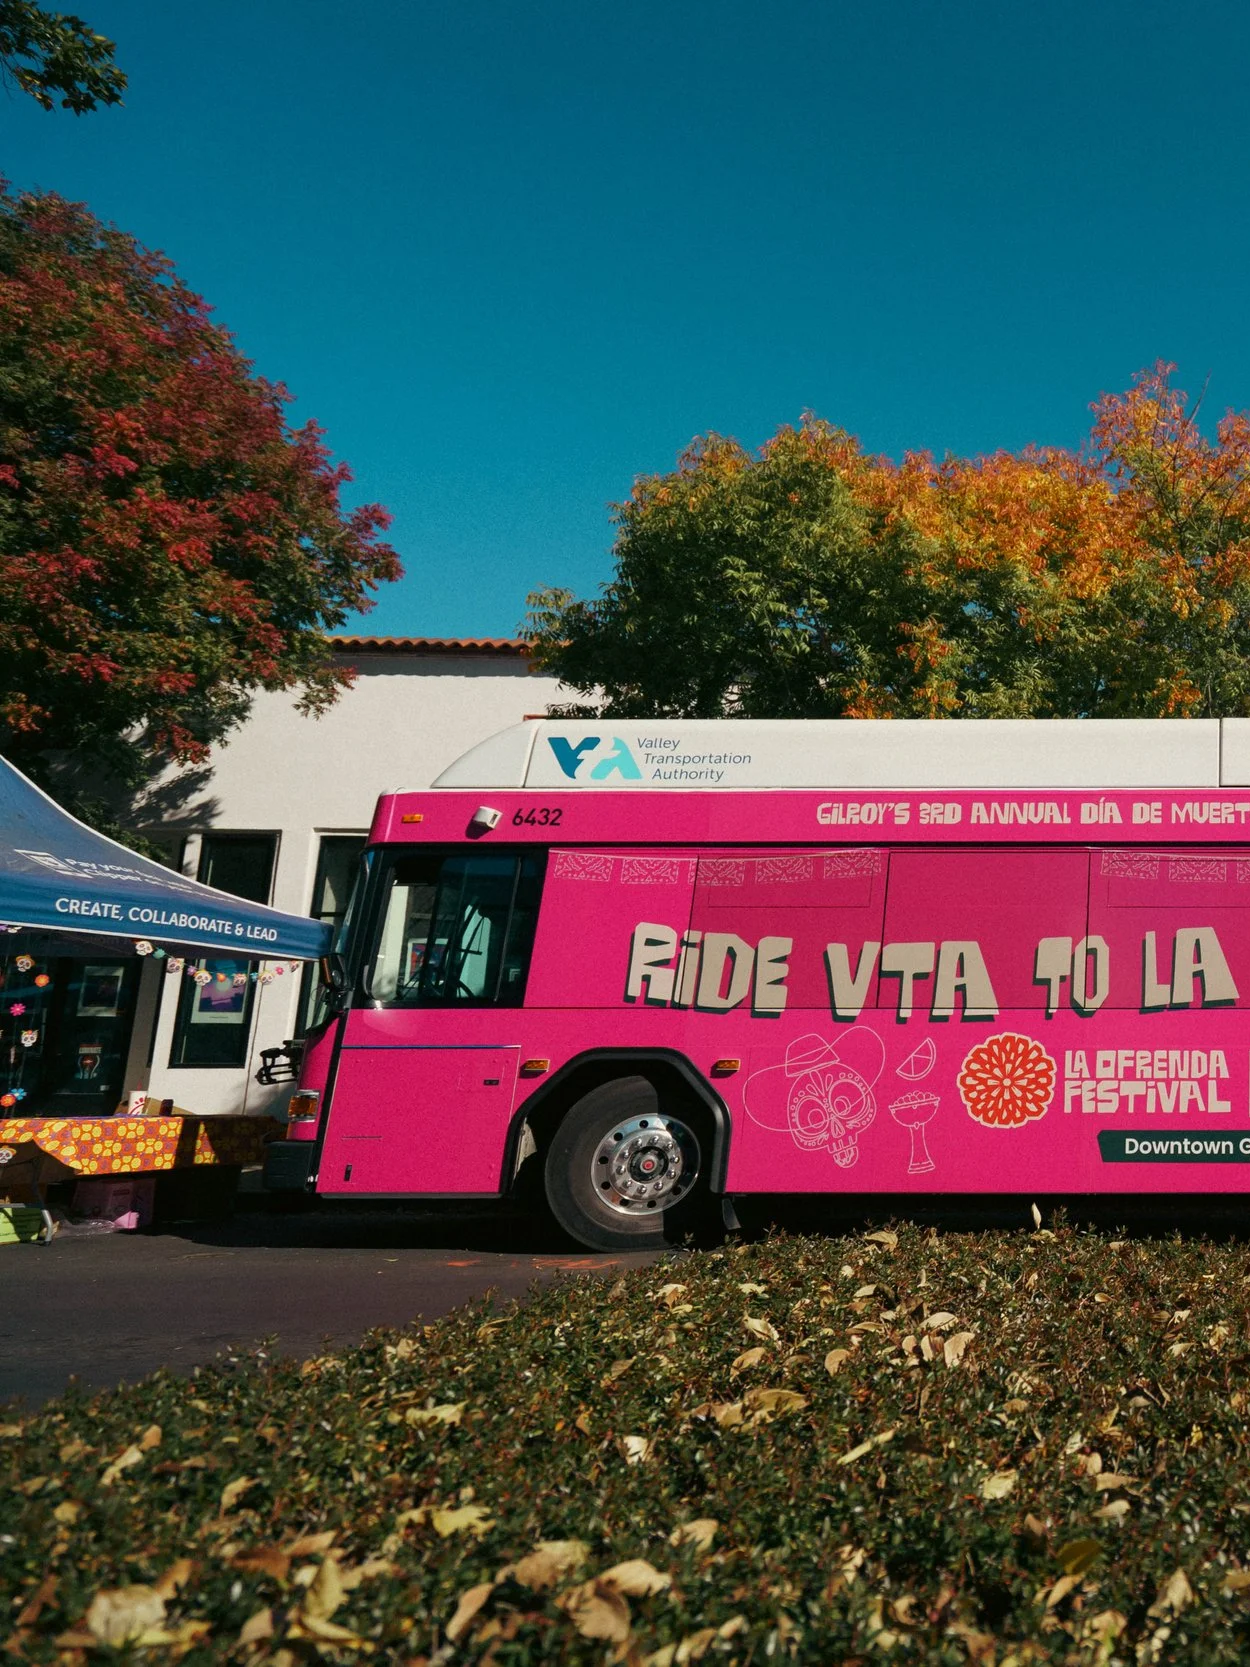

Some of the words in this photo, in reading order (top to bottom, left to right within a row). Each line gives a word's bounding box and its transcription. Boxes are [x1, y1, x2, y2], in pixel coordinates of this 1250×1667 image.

[637, 738, 680, 750] Valley
[644, 753, 752, 766] Transportation
[652, 768, 724, 782] Authority
[512, 808, 563, 827] 6432
[919, 802, 962, 824] 3RD
[970, 802, 1071, 824] ANNUAL
[1080, 796, 1123, 824] DÍA
[1132, 802, 1163, 824] DE
[55, 897, 124, 921] CREATE,
[128, 907, 233, 935] COLLABORATE
[234, 923, 244, 935] &
[246, 926, 278, 941] LEAD
[826, 941, 1000, 1022] VTA
[1033, 935, 1110, 1020] TO
[1139, 927, 1241, 1014] LA
[1063, 1050, 1090, 1078] LA
[1096, 1050, 1230, 1079] OFRENDA
[1125, 1137, 1235, 1156] Downtown
